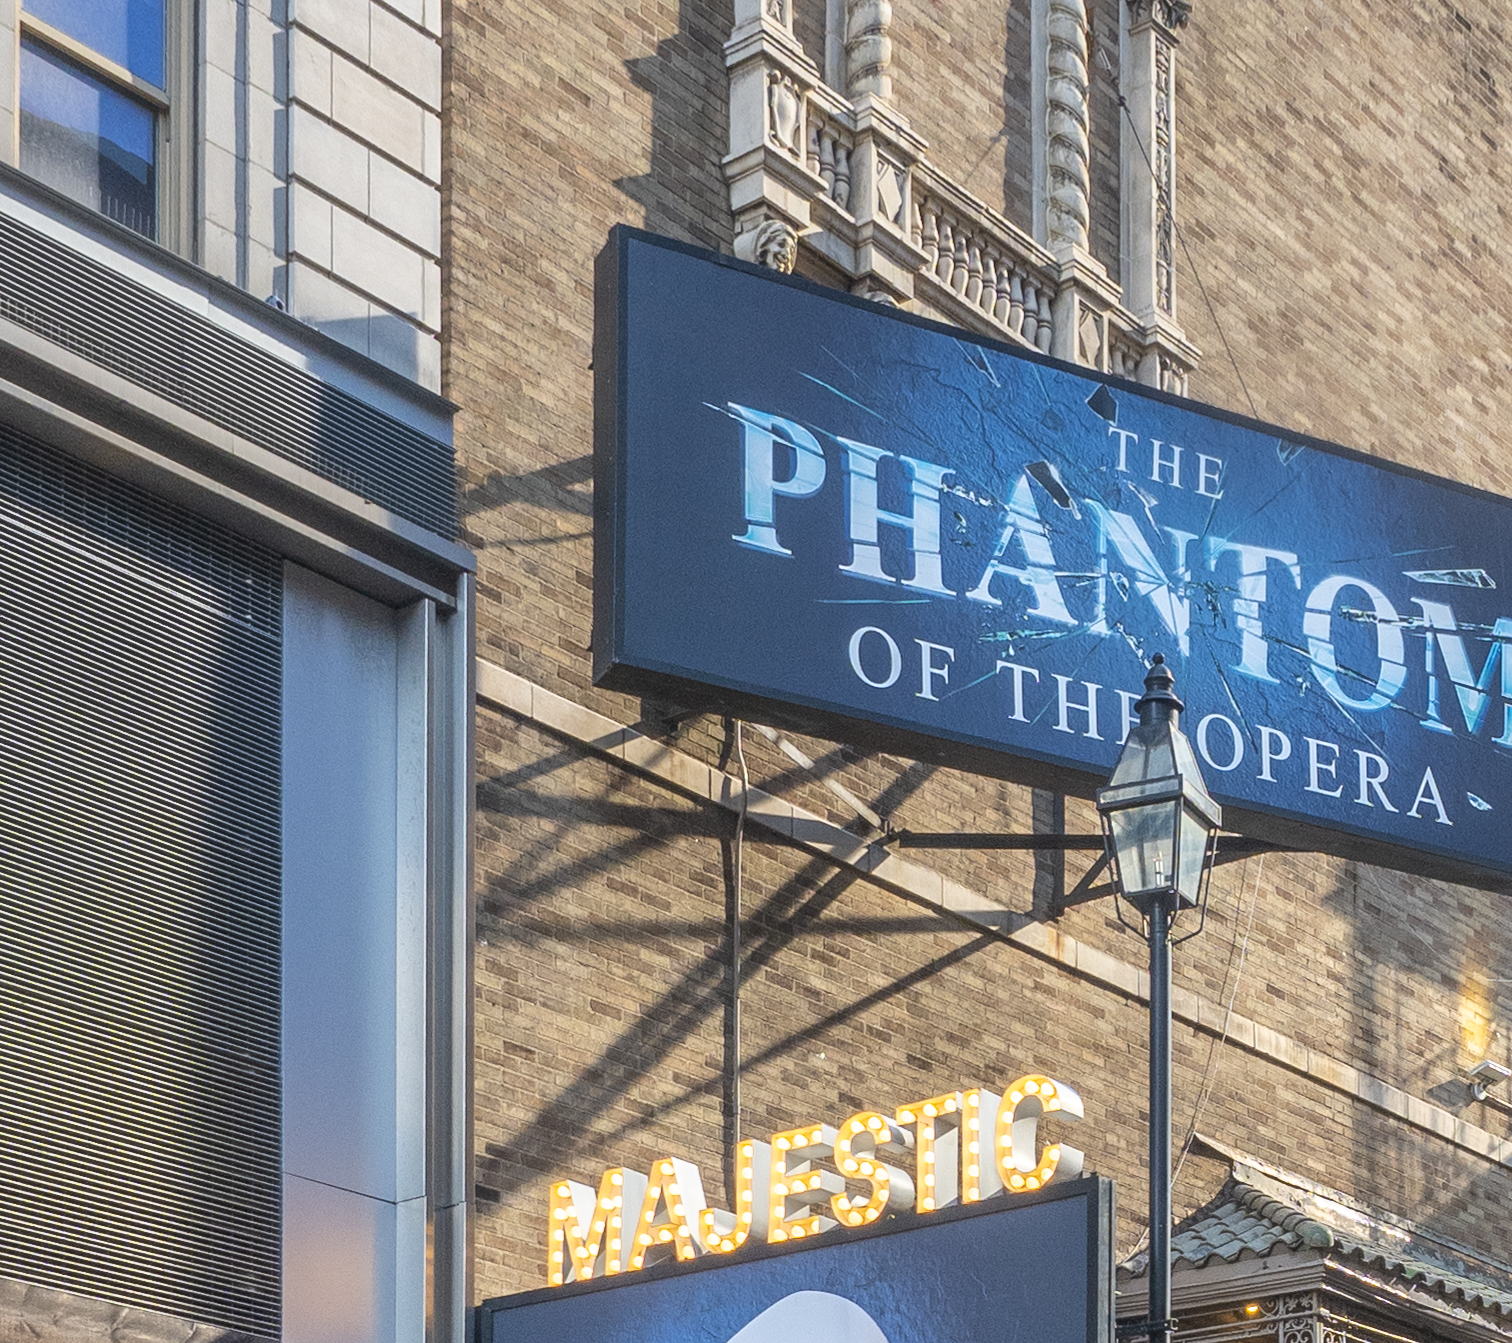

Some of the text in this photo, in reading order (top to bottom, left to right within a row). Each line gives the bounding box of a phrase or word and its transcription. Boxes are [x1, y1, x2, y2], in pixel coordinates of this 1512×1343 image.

[1108, 424, 1227, 502] THE
[846, 624, 957, 703] OF
[1196, 713, 1454, 827] OPERA
[547, 1073, 1085, 1288] MAJESTIC
